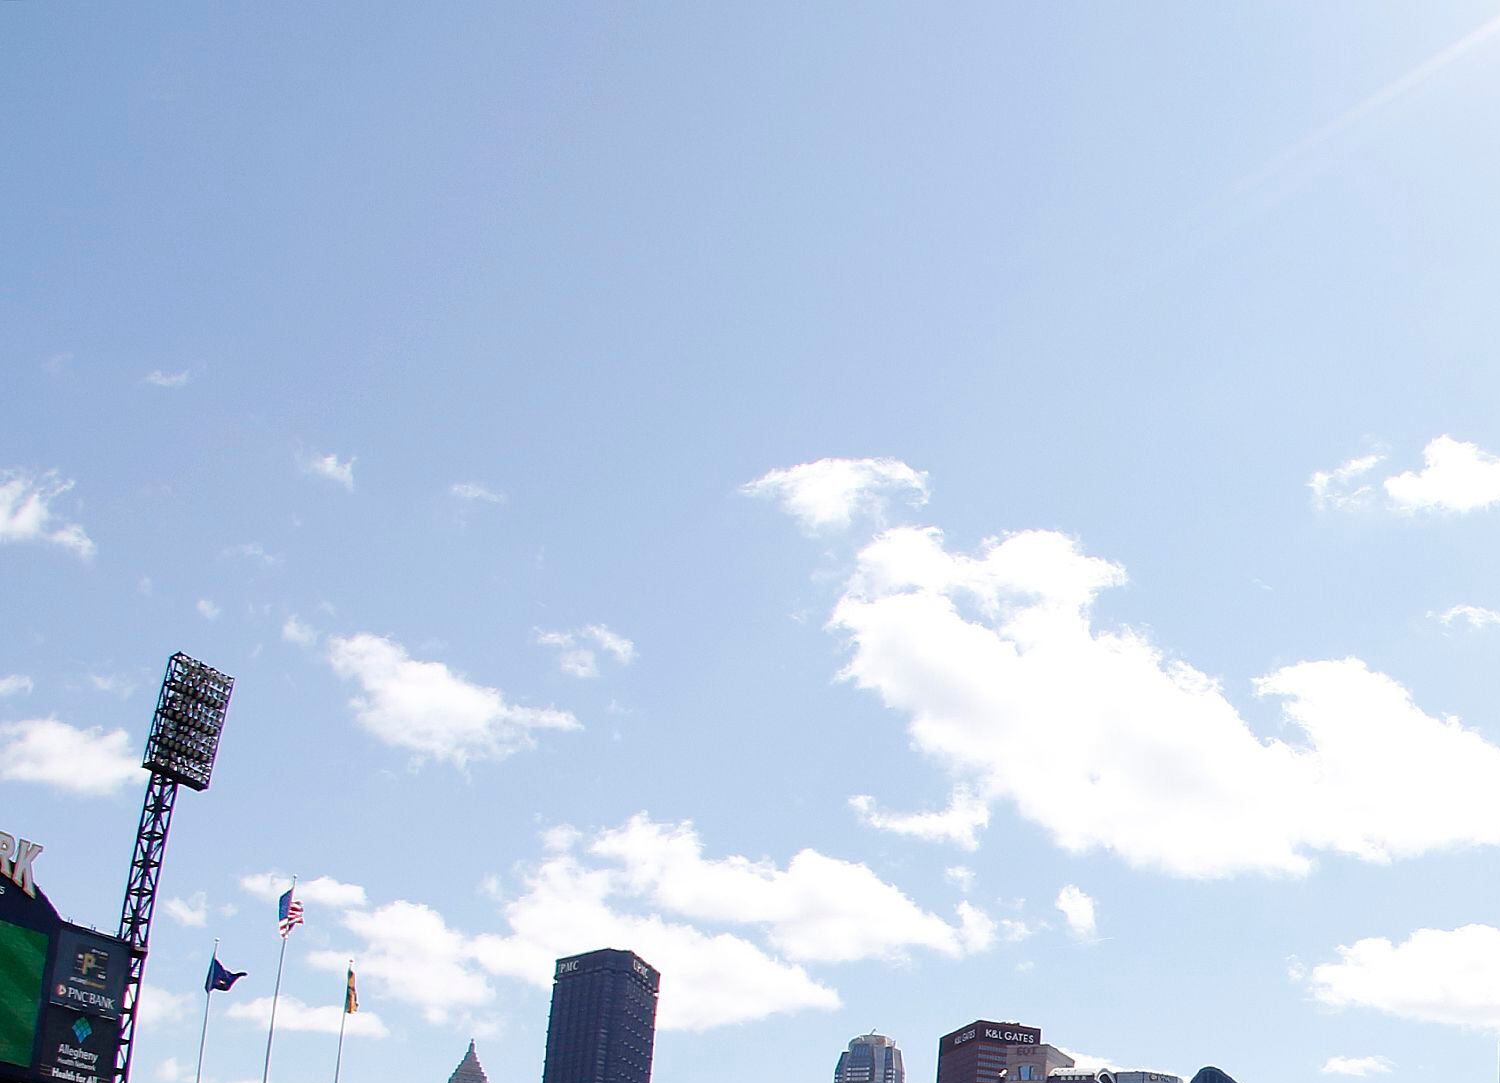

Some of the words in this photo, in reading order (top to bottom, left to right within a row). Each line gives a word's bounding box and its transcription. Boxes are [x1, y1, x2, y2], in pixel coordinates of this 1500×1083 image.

[985, 1028, 1003, 1041] K&L
[1004, 1031, 1034, 1044] GATES
[58, 1043, 98, 1064] Allegheny
[51, 1067, 75, 1080] Health
[75, 1071, 86, 1083] for
